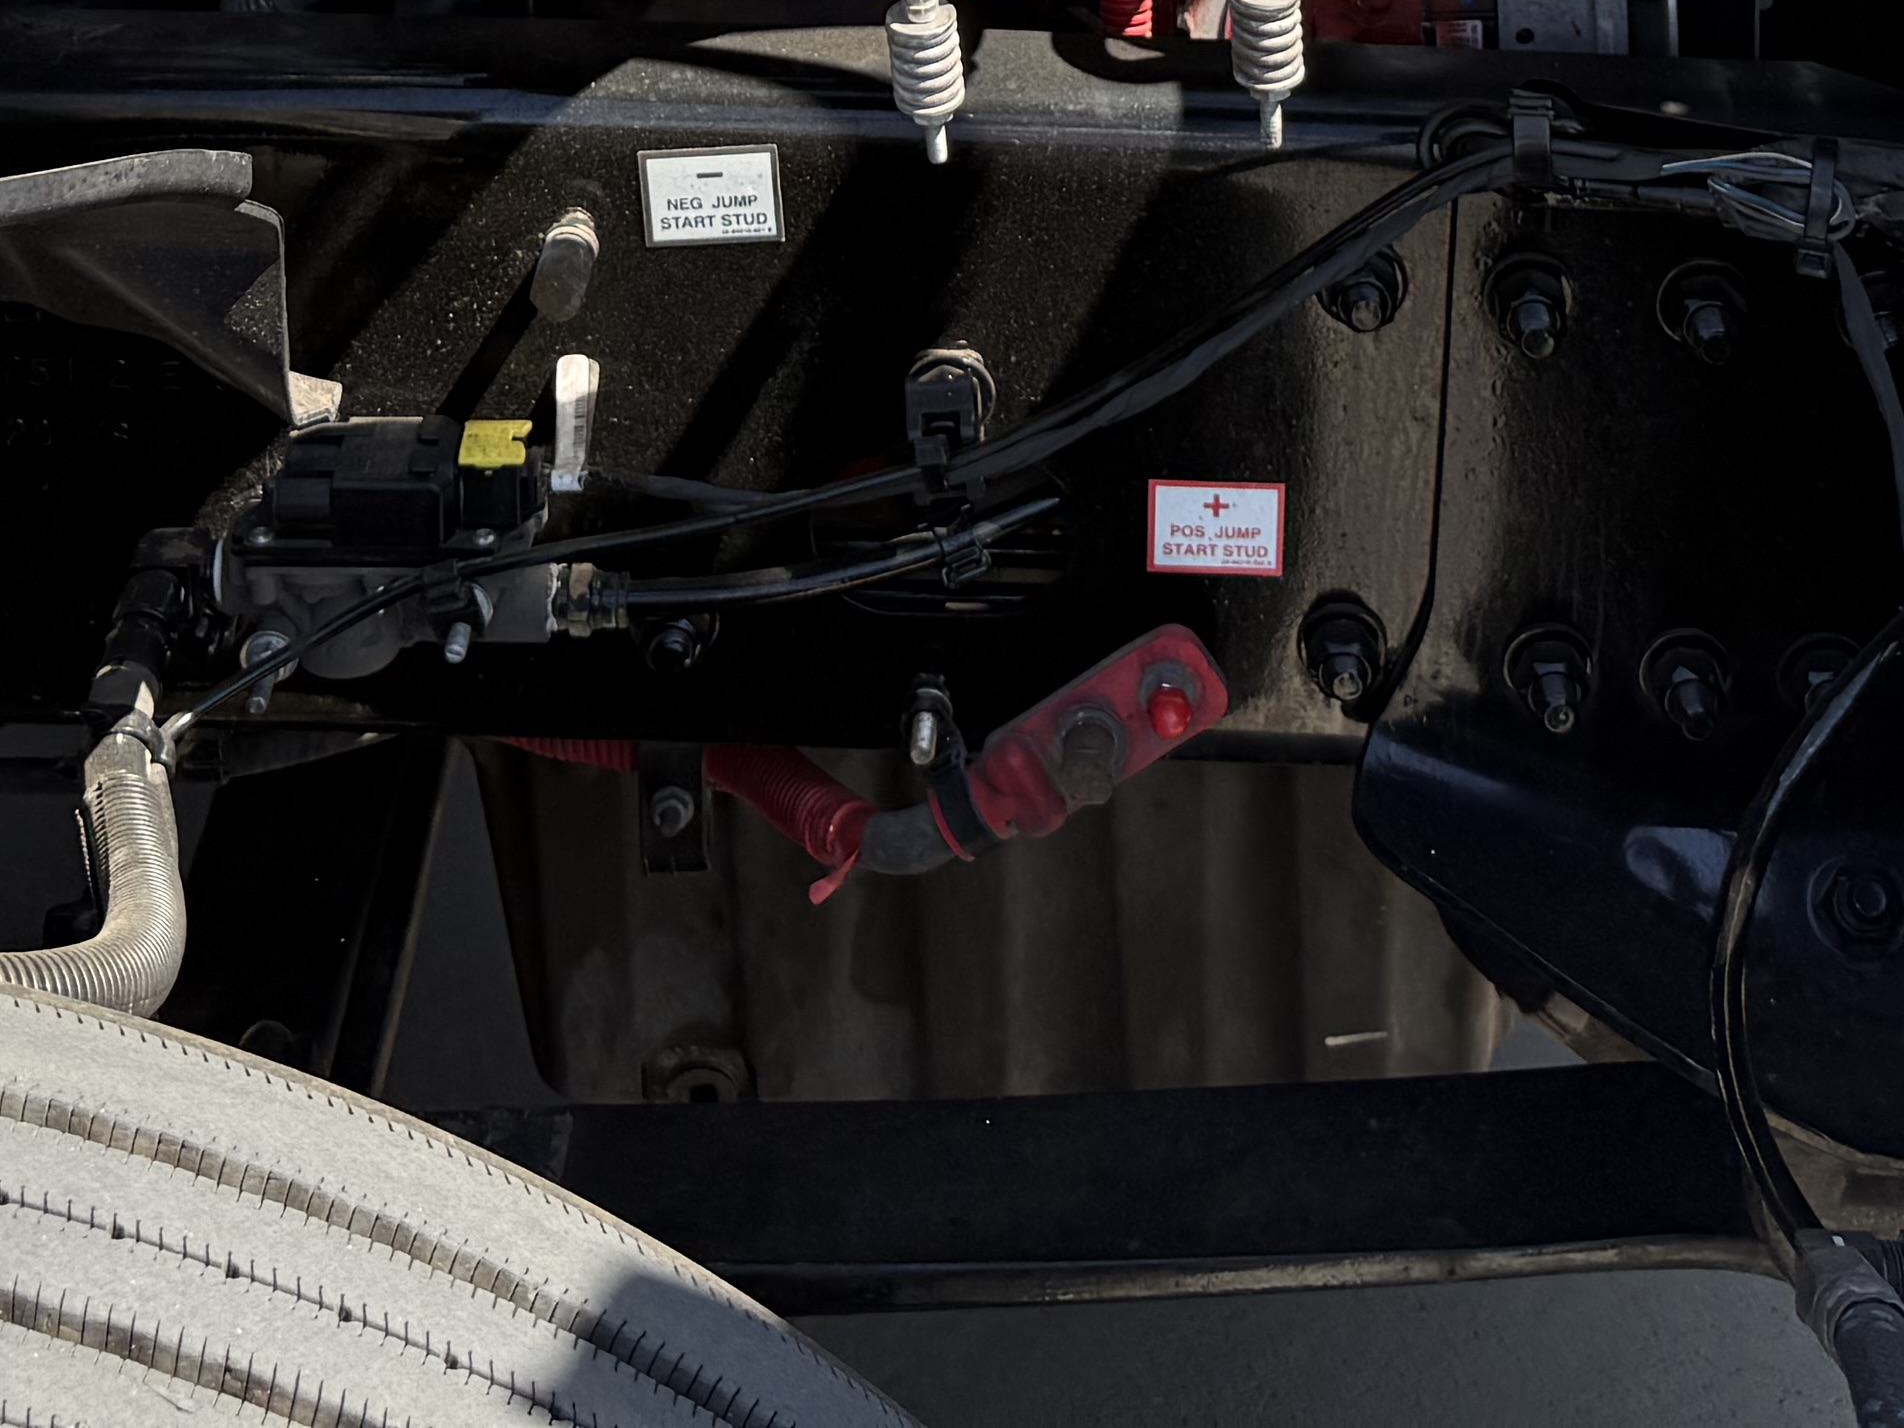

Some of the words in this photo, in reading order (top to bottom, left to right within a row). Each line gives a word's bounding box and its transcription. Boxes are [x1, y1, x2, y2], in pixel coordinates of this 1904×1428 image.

[667, 196, 703, 211] NEG
[712, 194, 758, 208] JUMP
[660, 214, 716, 230] START
[721, 212, 768, 227] STUD
[1170, 524, 1205, 538] POS
[1215, 526, 1261, 539] JUMP
[1162, 542, 1218, 556] START
[1223, 545, 1269, 557] STUD
